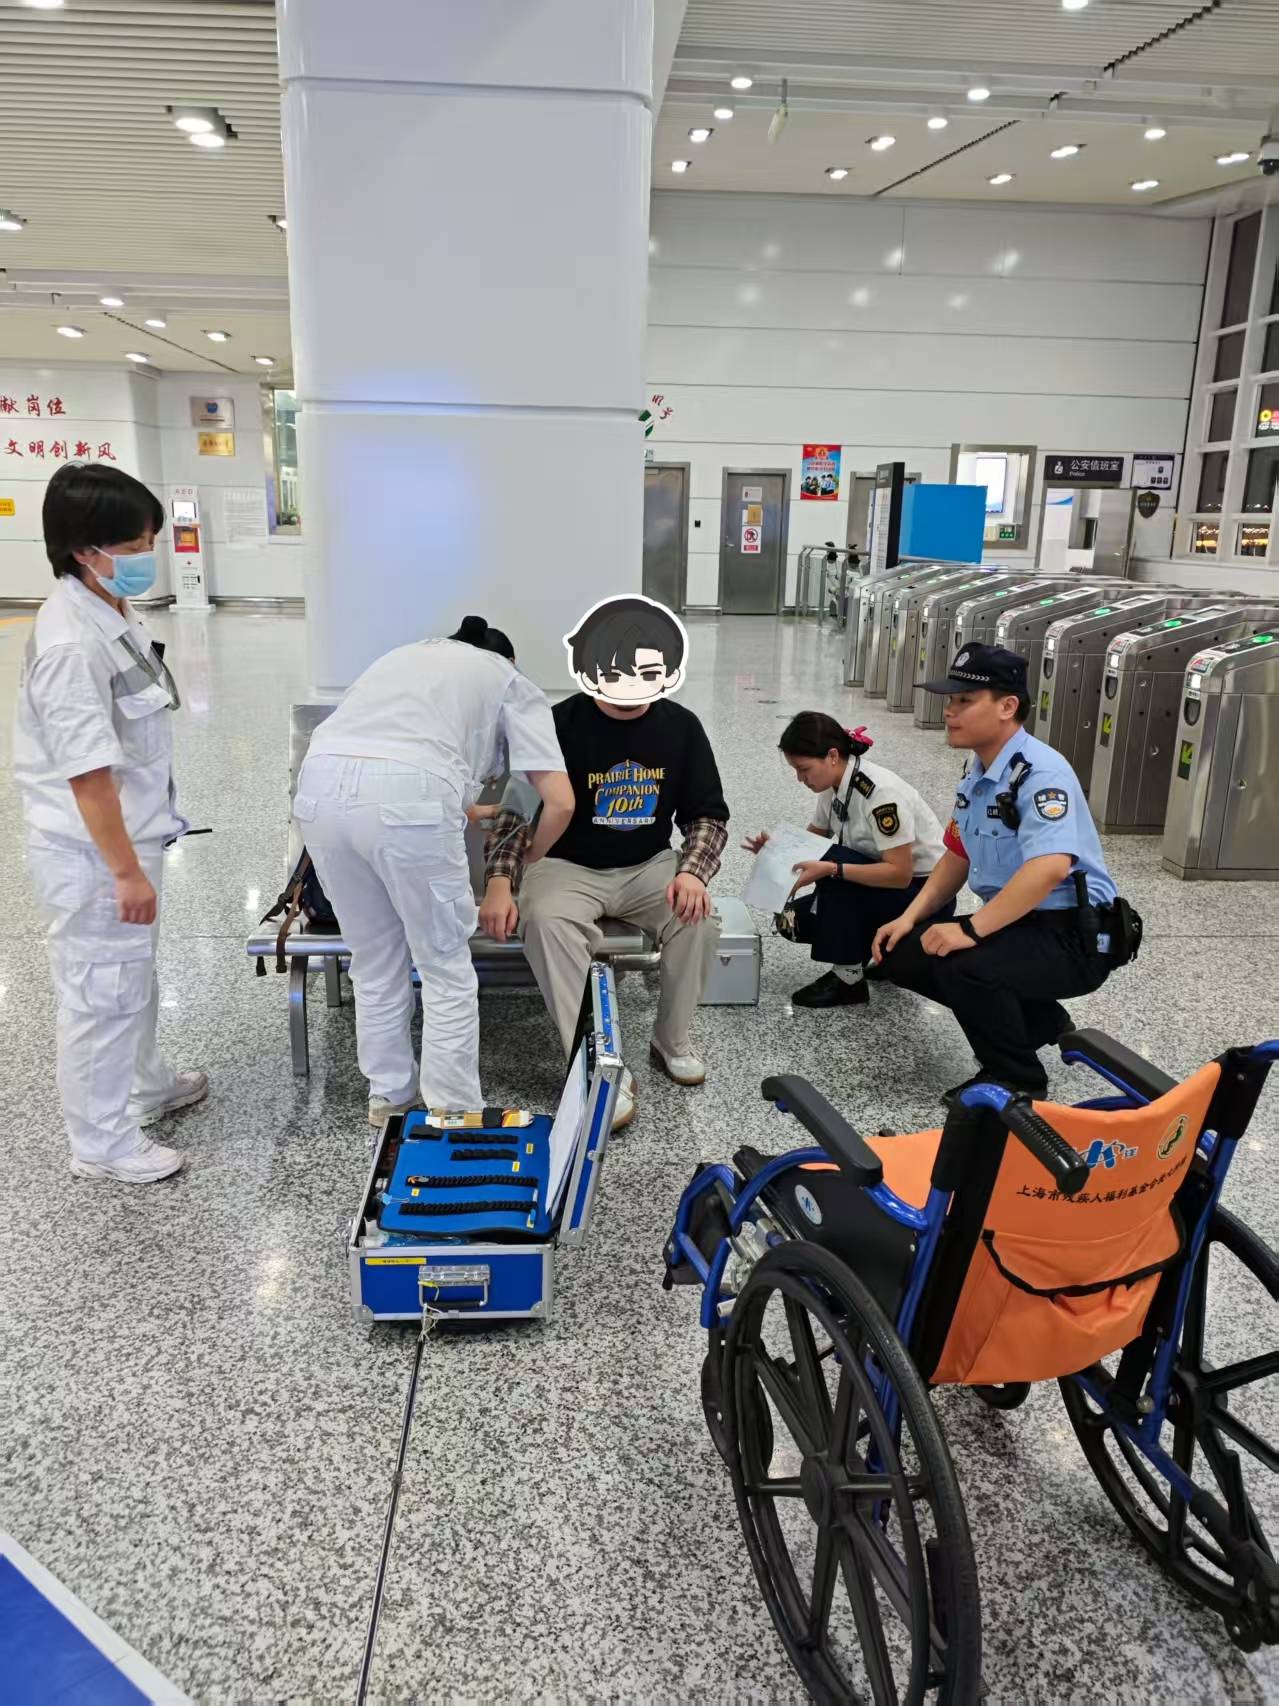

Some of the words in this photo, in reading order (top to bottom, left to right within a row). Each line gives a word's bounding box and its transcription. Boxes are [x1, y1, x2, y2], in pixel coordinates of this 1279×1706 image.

[4, 438, 116, 460] 文明创新风
[1070, 459, 1120, 471] 公安值班室
[588, 768, 632, 789] PRAIRIE
[633, 767, 666, 782] HOME
[595, 784, 660, 806] COMPANION
[606, 795, 643, 818] 10th
